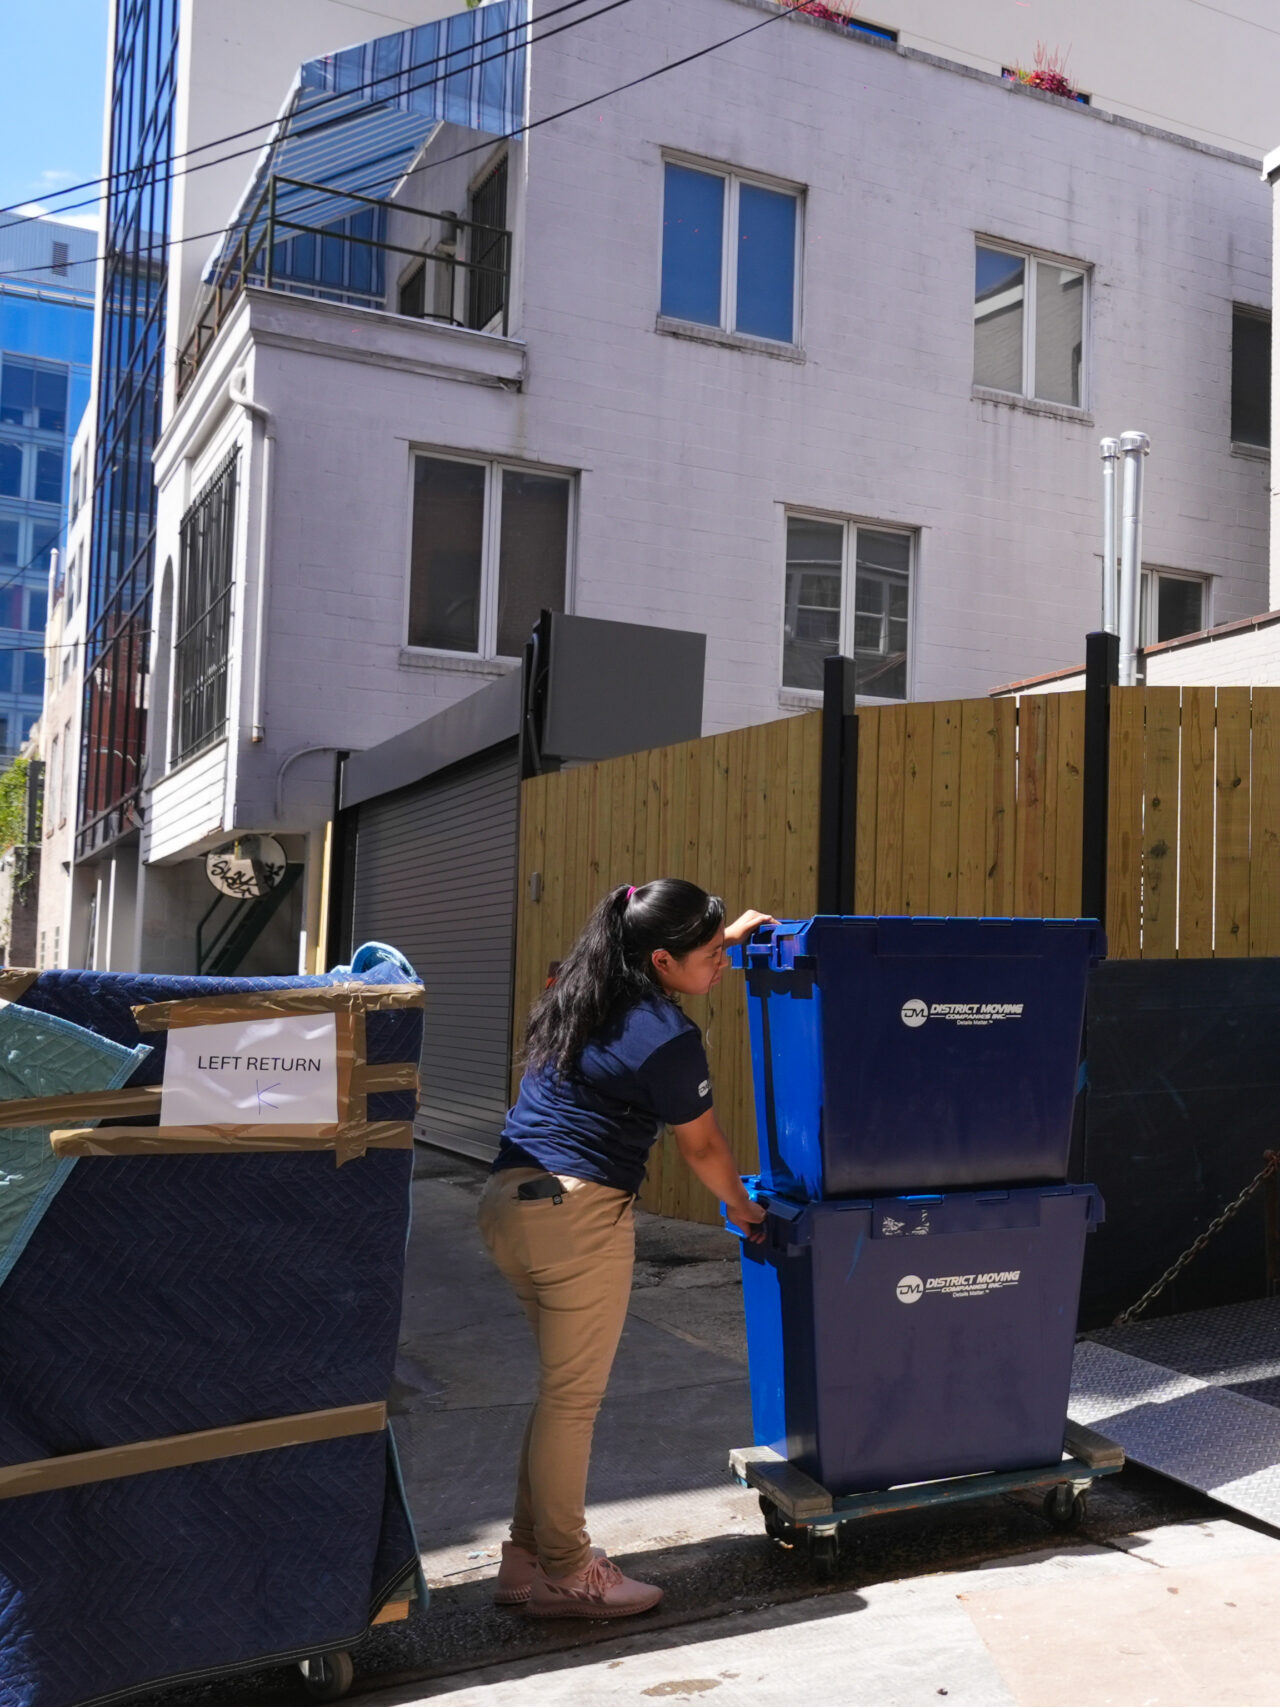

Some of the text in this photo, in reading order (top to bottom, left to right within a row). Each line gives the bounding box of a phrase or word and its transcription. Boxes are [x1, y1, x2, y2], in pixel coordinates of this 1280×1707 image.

[930, 1004, 1024, 1014] DISTRICT MOVING
[197, 1055, 321, 1072] LEFT RETURN
[255, 1079, 281, 1116] K
[925, 1270, 1021, 1289] DISTRICT MOVING
[941, 1283, 987, 1293] COMPANIES
